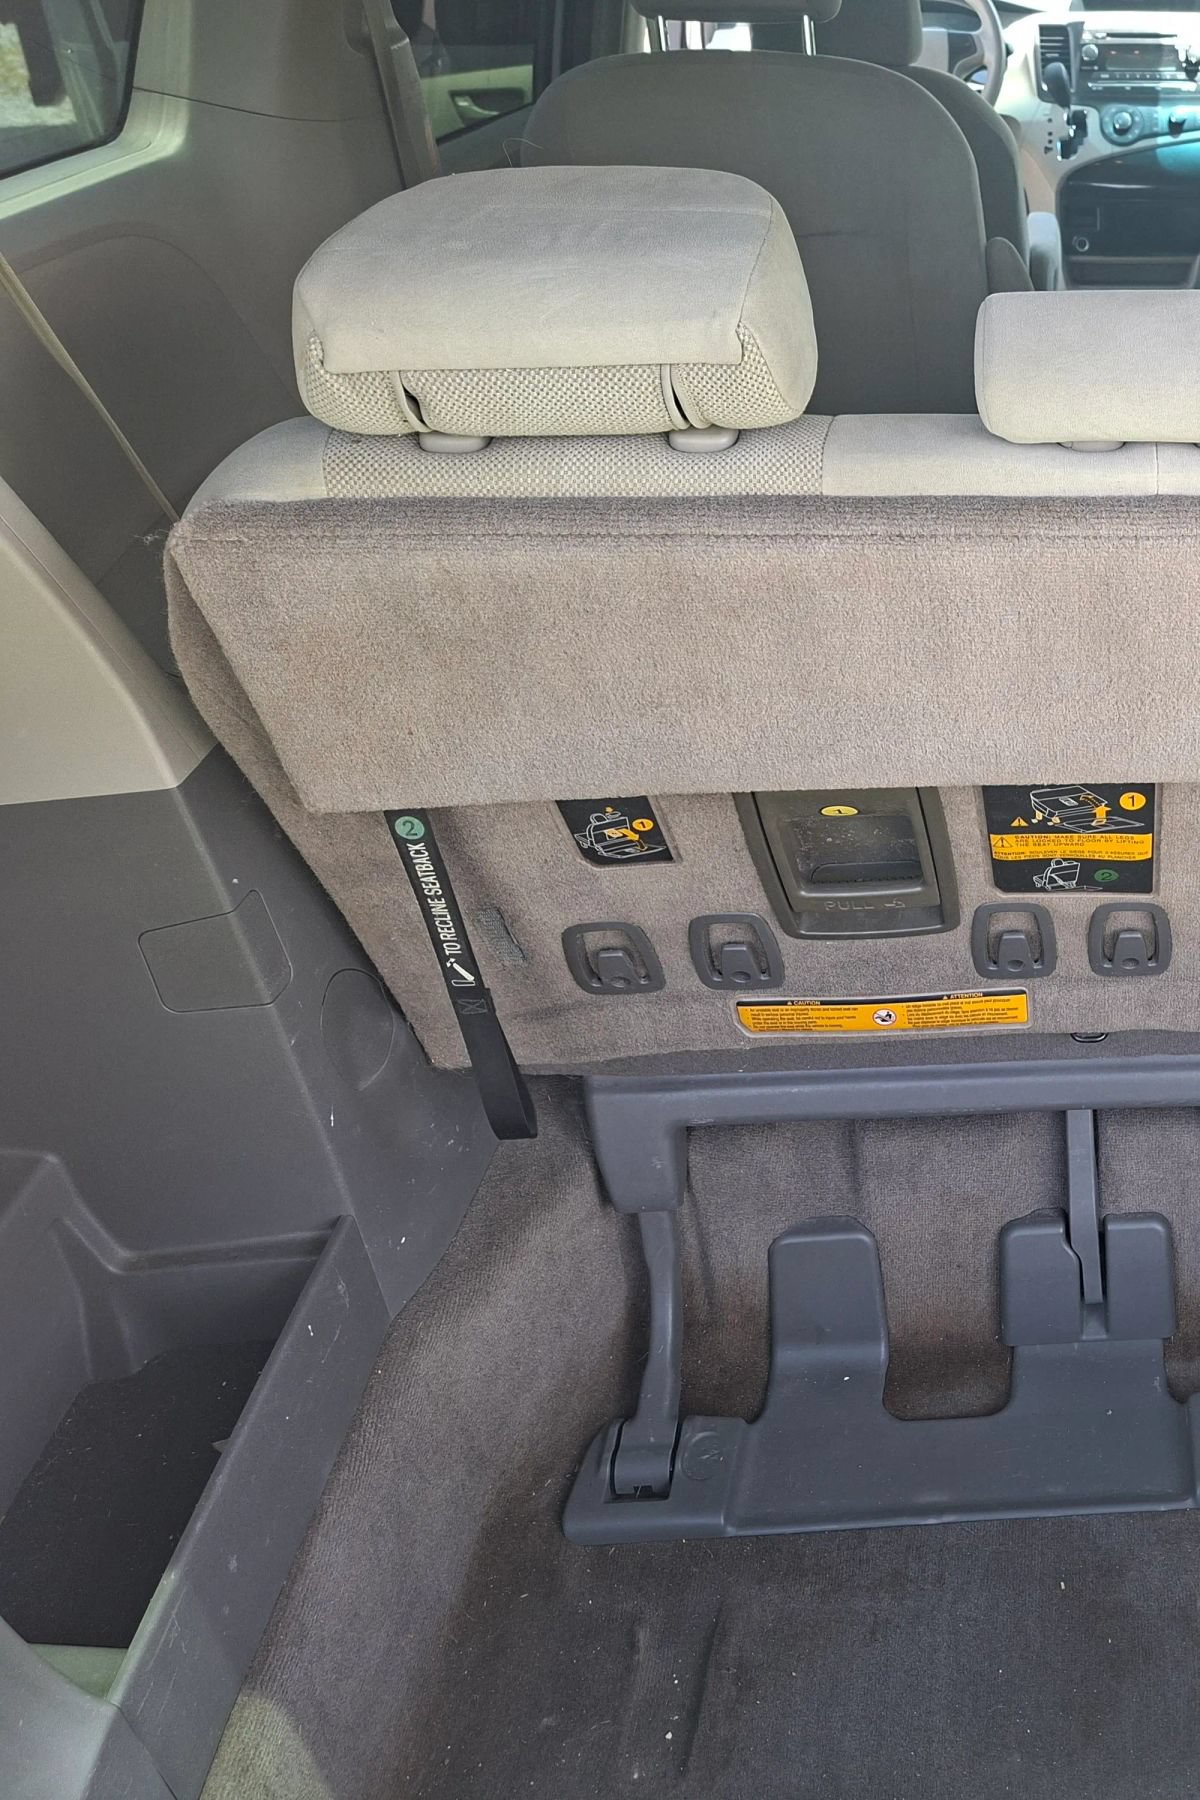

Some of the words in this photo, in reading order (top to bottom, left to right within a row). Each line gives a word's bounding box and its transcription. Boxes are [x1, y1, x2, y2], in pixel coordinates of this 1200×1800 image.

[402, 820, 419, 837] 2
[406, 842, 443, 897] SEATBACK
[1100, 871, 1113, 880] 2
[823, 900, 876, 911] PULL
[426, 897, 458, 941] RECLINE
[442, 942, 463, 957] TO
